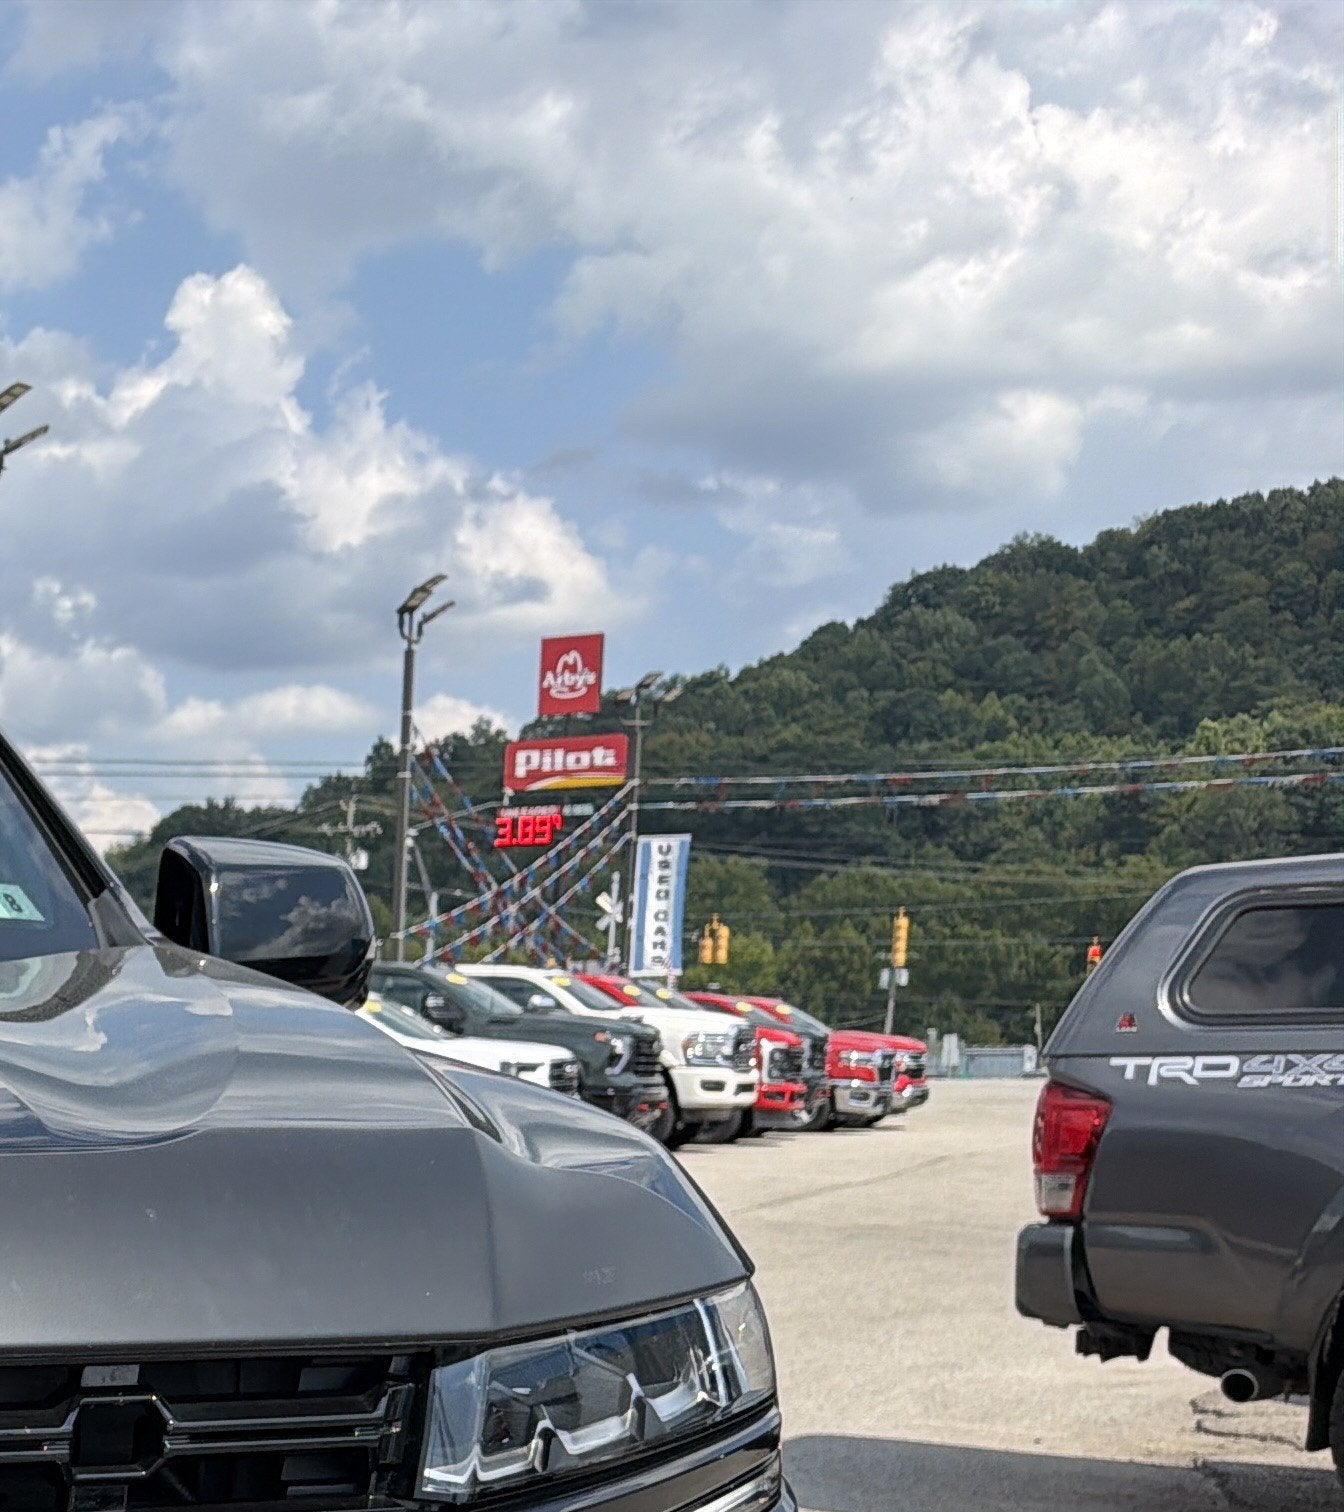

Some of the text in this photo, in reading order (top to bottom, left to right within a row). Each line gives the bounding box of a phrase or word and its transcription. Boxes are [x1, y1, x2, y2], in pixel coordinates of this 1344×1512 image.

[542, 667, 597, 690] Arby's
[514, 746, 617, 779] Pilot
[1109, 1055, 1240, 1087] TRD
